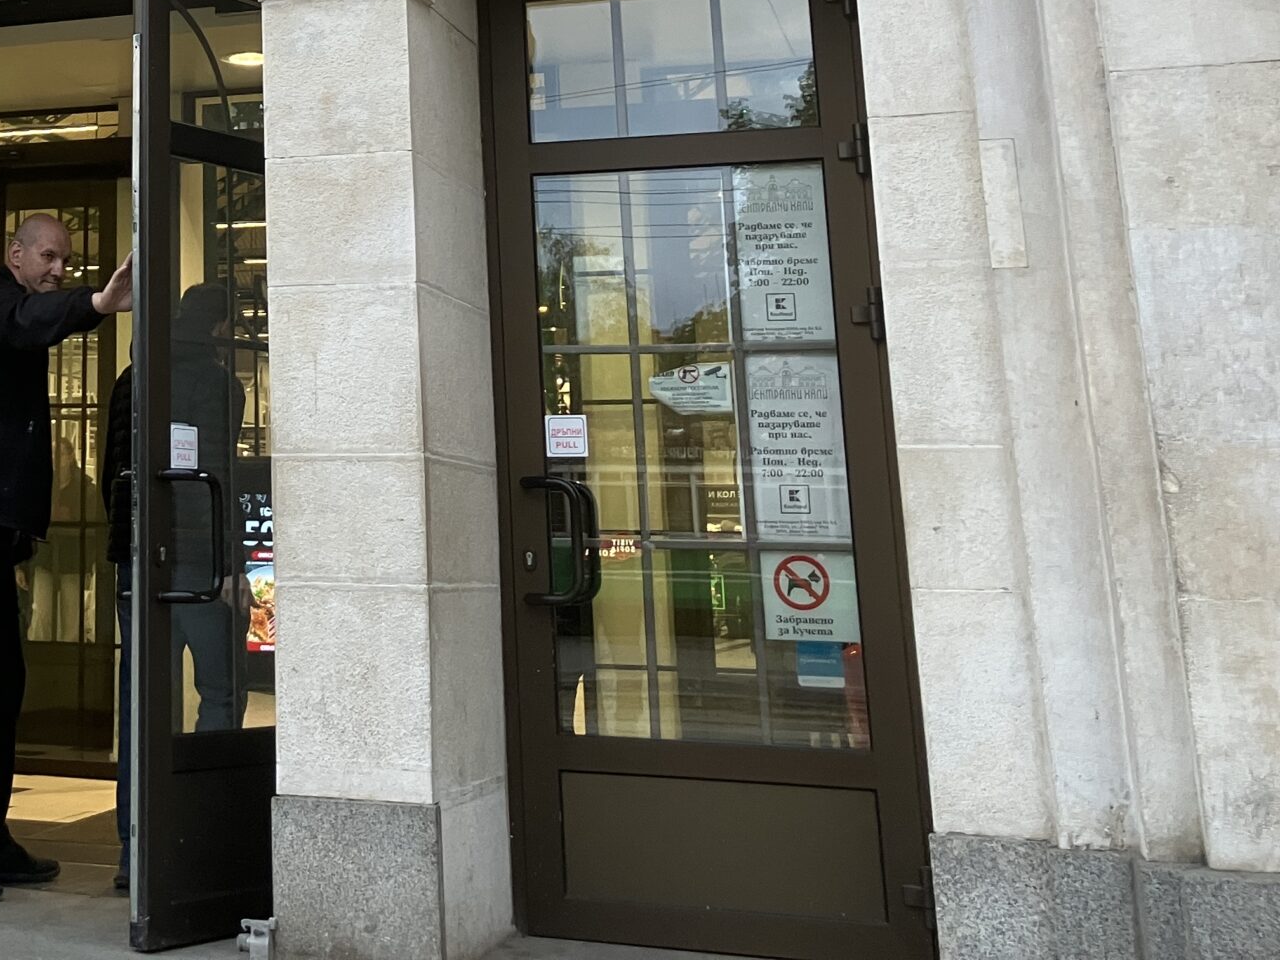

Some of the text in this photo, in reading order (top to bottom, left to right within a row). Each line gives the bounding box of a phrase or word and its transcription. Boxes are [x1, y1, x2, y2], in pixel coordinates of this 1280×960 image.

[738, 222, 782, 232] Радваме
[745, 231, 807, 242] пазарувате
[755, 243, 774, 252] при
[786, 257, 819, 267] време
[784, 267, 807, 277] Нед.
[781, 277, 809, 286] 22:00
[751, 409, 827, 420] Радваме се, че
[758, 420, 821, 430] пазарувате
[768, 431, 812, 440] при нас.
[555, 441, 579, 449] PULL
[751, 446, 833, 457] Работно време
[176, 452, 193, 462] PULL
[762, 457, 787, 466] Пон.
[798, 457, 822, 468] Нед.
[762, 469, 783, 478] 7:00
[795, 469, 824, 478] 22:00
[776, 614, 834, 625] Забранено
[778, 626, 833, 637] за кучета
